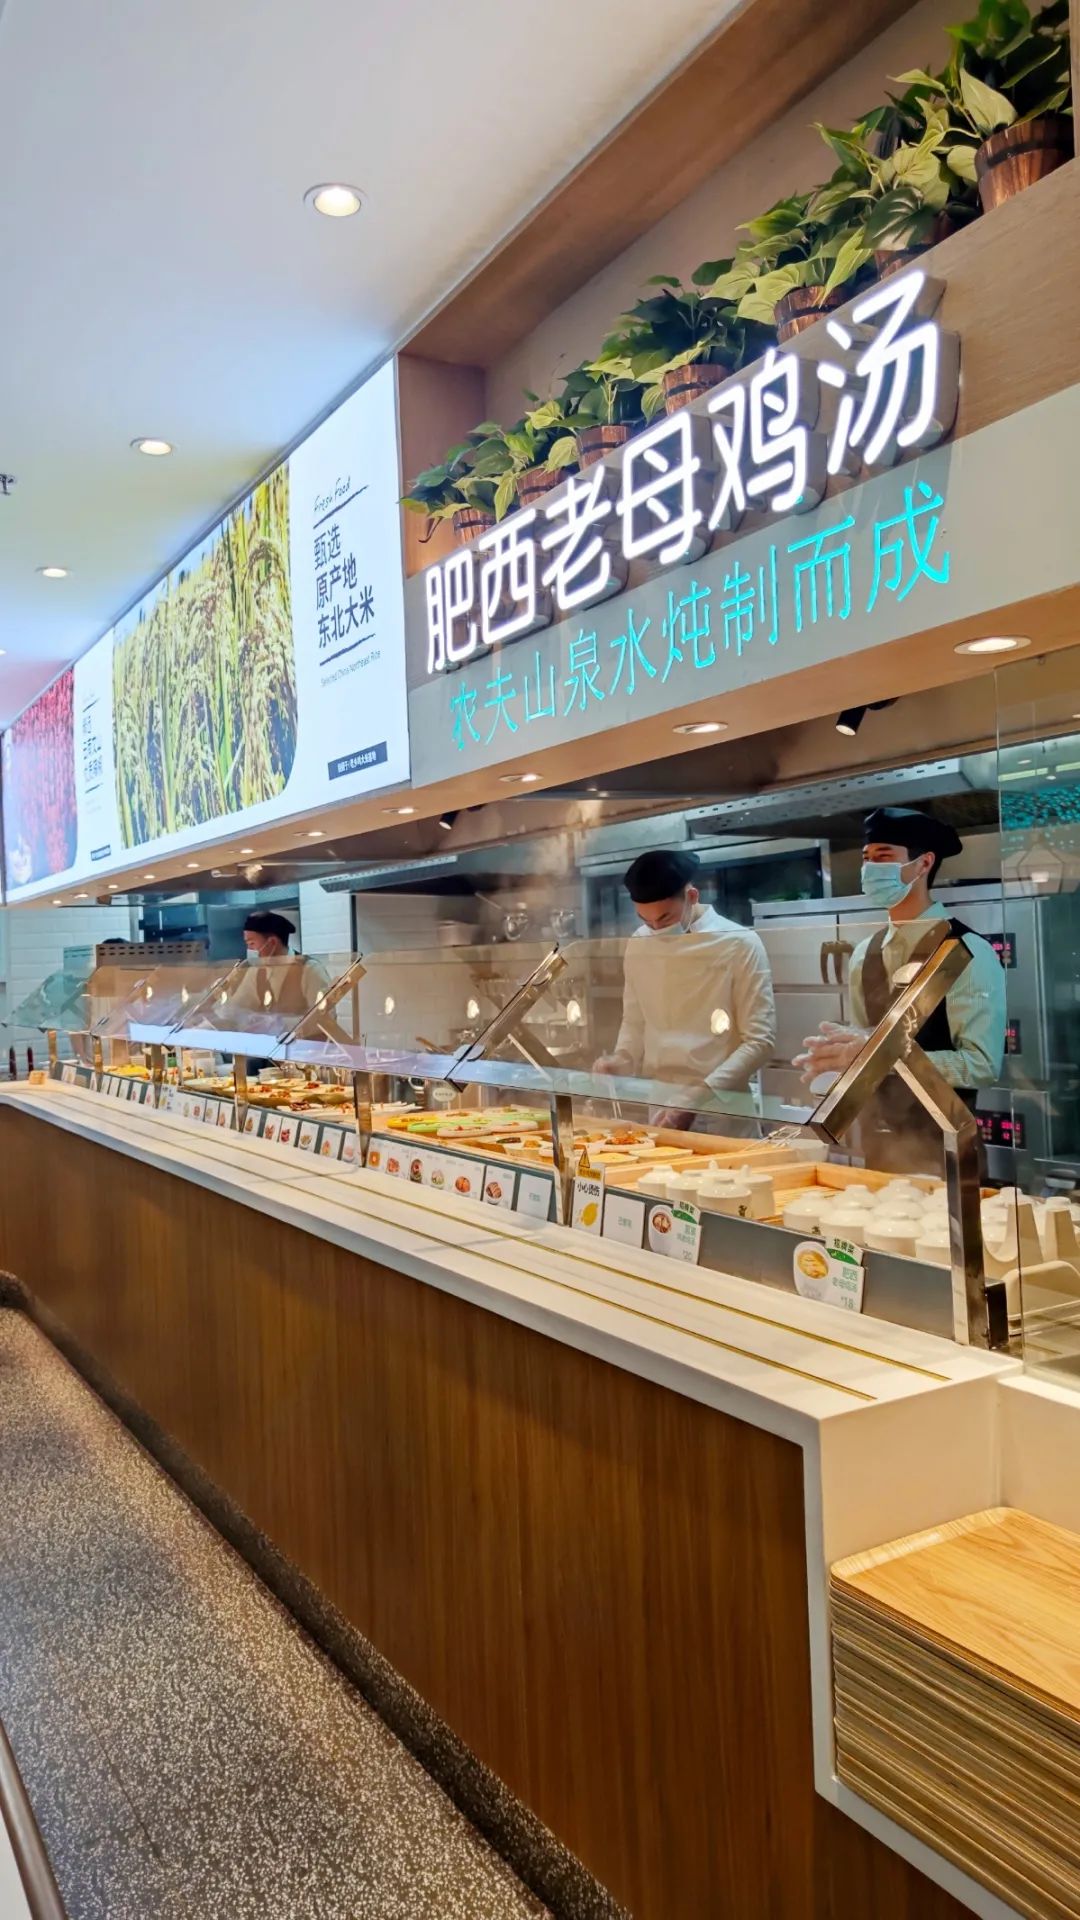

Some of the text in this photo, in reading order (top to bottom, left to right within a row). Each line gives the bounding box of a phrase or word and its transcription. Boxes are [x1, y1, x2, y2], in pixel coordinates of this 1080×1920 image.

[426, 268, 941, 675] 肥西老母鸡汤
[313, 522, 341, 570] 甄选
[316, 551, 358, 611] 原产地
[317, 584, 375, 649] 东北大米
[448, 480, 952, 752] 农夫山泉水炖制而成
